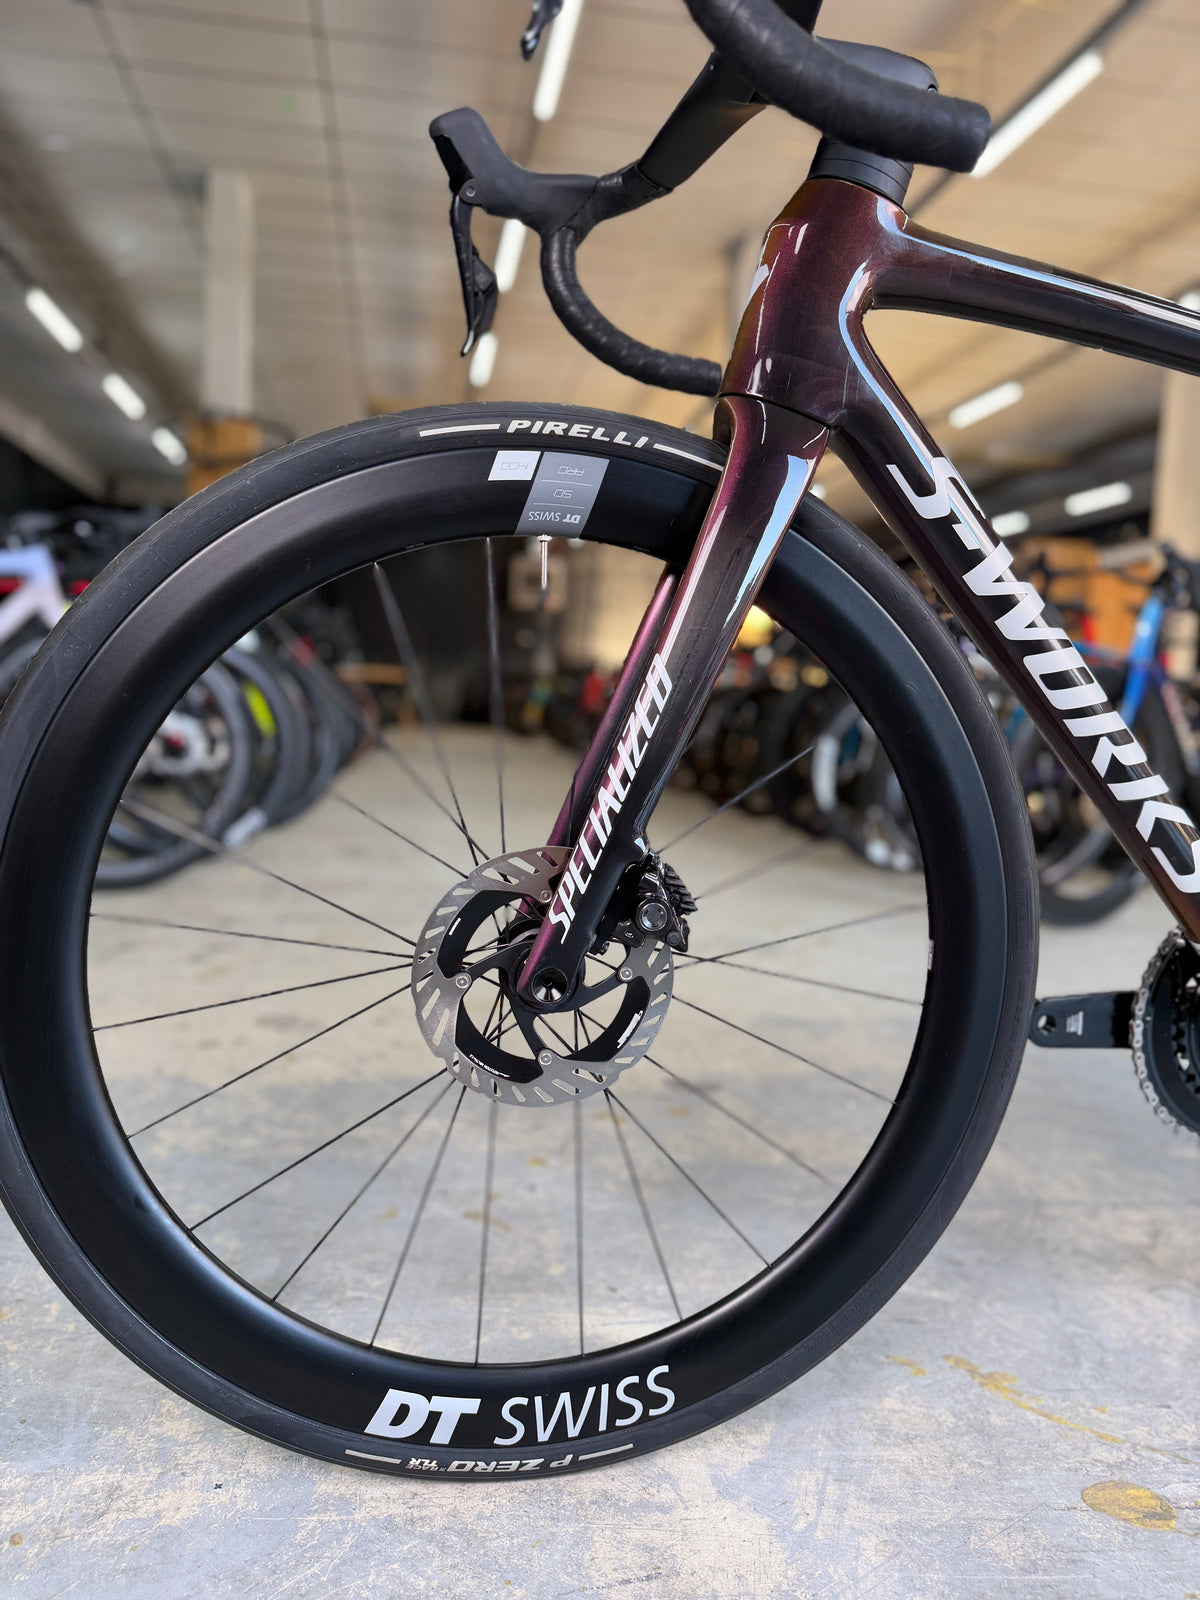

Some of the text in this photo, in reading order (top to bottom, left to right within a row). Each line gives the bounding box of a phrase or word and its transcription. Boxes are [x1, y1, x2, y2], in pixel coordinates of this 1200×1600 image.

[506, 419, 649, 449] PIRELLI
[553, 488, 574, 499] 50
[528, 511, 582, 524] DT SWISS
[548, 652, 673, 945] SPECIALIZED
[363, 1364, 677, 1446] DT SWISS
[409, 1457, 438, 1467] TLR
[446, 1453, 574, 1473] P ZERO
